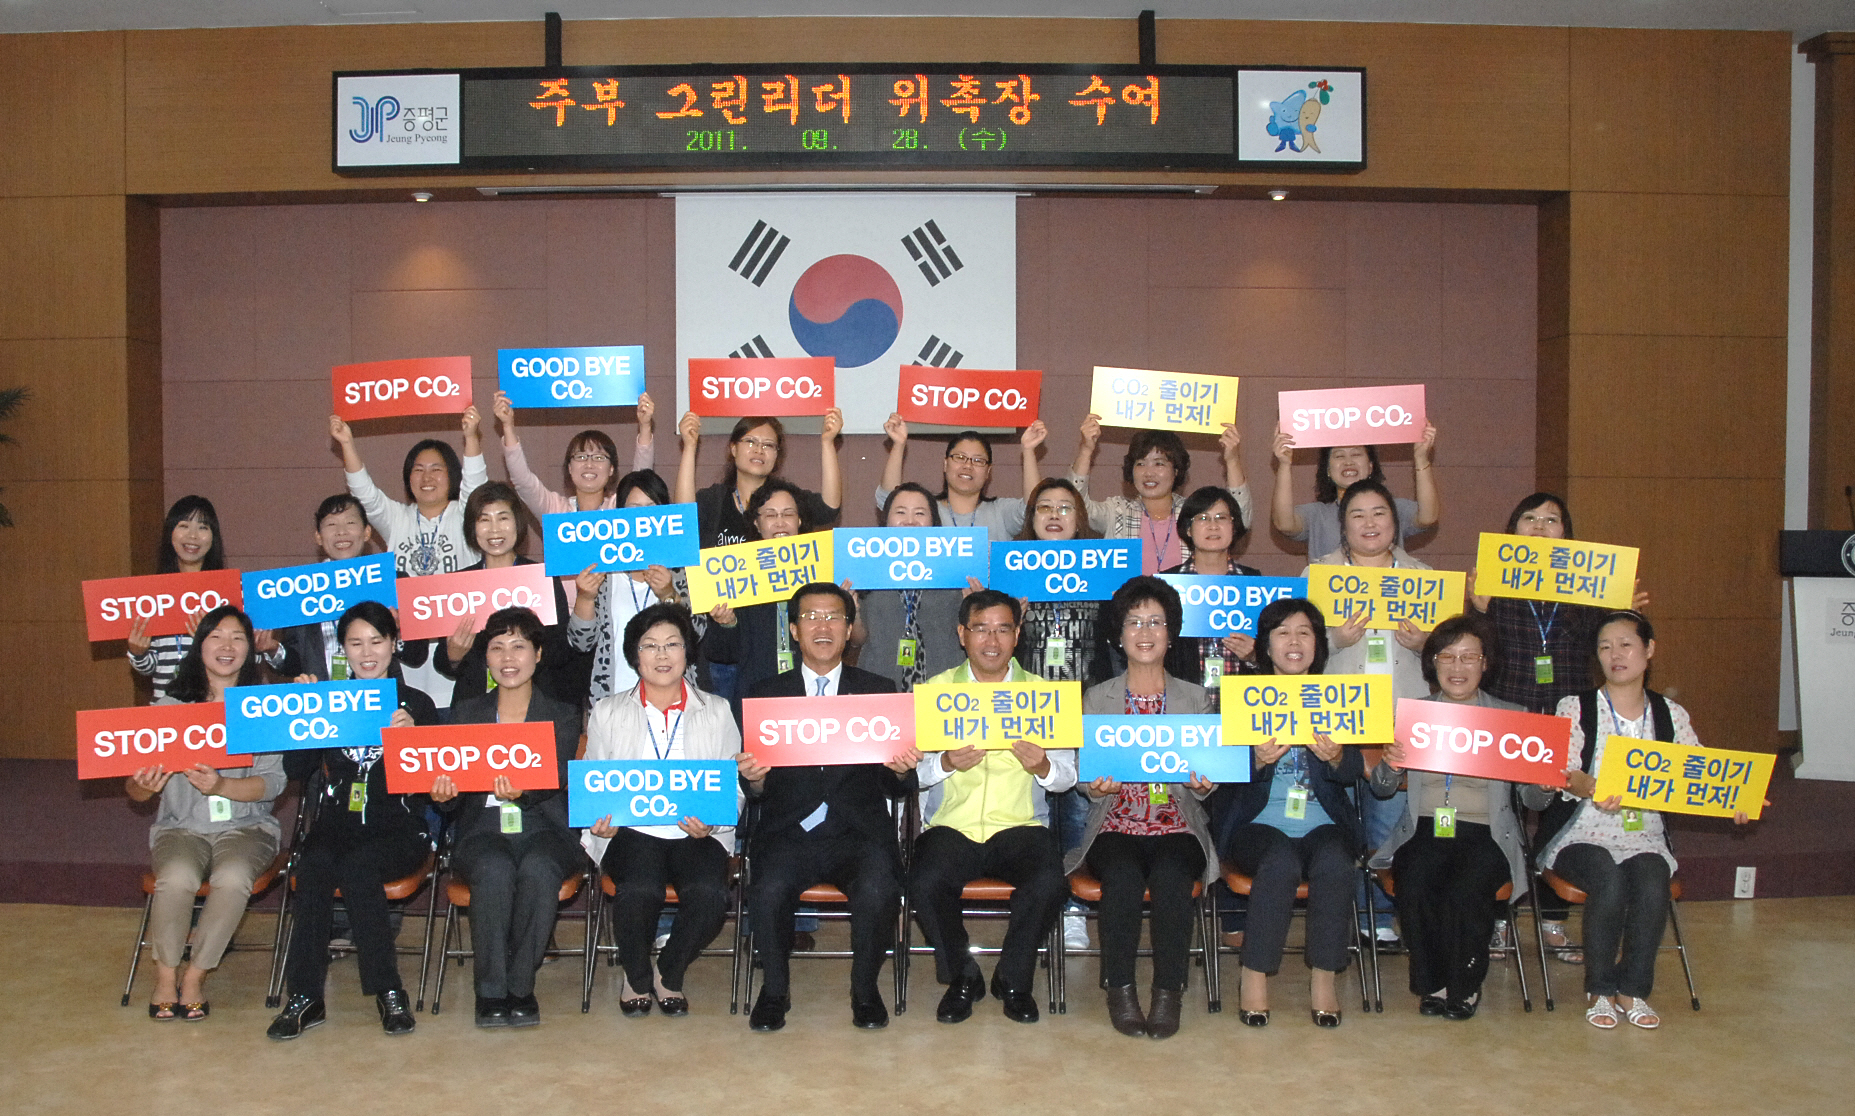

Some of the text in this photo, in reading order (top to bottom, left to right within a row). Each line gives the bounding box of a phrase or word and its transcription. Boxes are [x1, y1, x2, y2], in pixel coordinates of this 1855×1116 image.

[529, 74, 1160, 126] 주부 그린리더 위촉장 수여
[403, 106, 448, 131] 증평군
[386, 133, 447, 145] Jeung Pyeong
[687, 130, 747, 151] 2011.
[892, 128, 928, 149] 28.
[959, 127, 1007, 150] (수)
[512, 353, 630, 377] GOOD BYE
[345, 376, 460, 404] STOP CO2
[552, 380, 592, 399] CO2
[702, 377, 822, 399] STOP CO2
[911, 384, 1027, 410] STOP CO2
[1112, 378, 1218, 403] CO2 줄이기
[1116, 400, 1210, 425] 내가 먼저!
[1293, 405, 1412, 431] STOP CO2
[558, 515, 684, 543] GOOD BYE
[600, 542, 644, 564] CO2
[705, 540, 819, 575] CO2 줄이기
[848, 537, 973, 557] GOOD BYE
[1006, 549, 1128, 570] GOOD BYE
[1500, 544, 1616, 575] CO2 줄이기
[258, 564, 382, 600] GOOD BYE
[716, 565, 816, 598] 내가 먼저!
[890, 561, 932, 581] CO2
[1046, 573, 1088, 593] CO2
[1502, 568, 1606, 598] 내가 먼저!
[1330, 575, 1444, 600] CO2 줄이기
[101, 594, 174, 621] STOP
[301, 594, 344, 616] CO2
[413, 586, 542, 620] STOP CO2
[1334, 598, 1436, 623] 내가 먼저!
[1209, 609, 1252, 630] CO2
[1830, 627, 1855, 637] Jeun
[242, 690, 381, 718] GOOD BYE
[938, 690, 1060, 713] CO2 줄이기
[1244, 684, 1370, 708] CO2 줄이기
[290, 717, 338, 740] CO2
[759, 716, 900, 745] STOP CO2
[944, 716, 1054, 740] 내가 먼저!
[1252, 710, 1364, 735] 내가 먼저!
[94, 728, 177, 757] STOP
[1096, 725, 1174, 747] GOOD
[1410, 722, 1553, 763] STOP CO2
[400, 746, 480, 772] STOP
[487, 744, 542, 769] CO2
[1141, 751, 1188, 773] CO2
[1628, 749, 1754, 784] CO2 줄이기
[585, 770, 720, 792] GOOD BYE
[1628, 776, 1740, 809] 내가 먼저!
[630, 795, 677, 817] CO2
